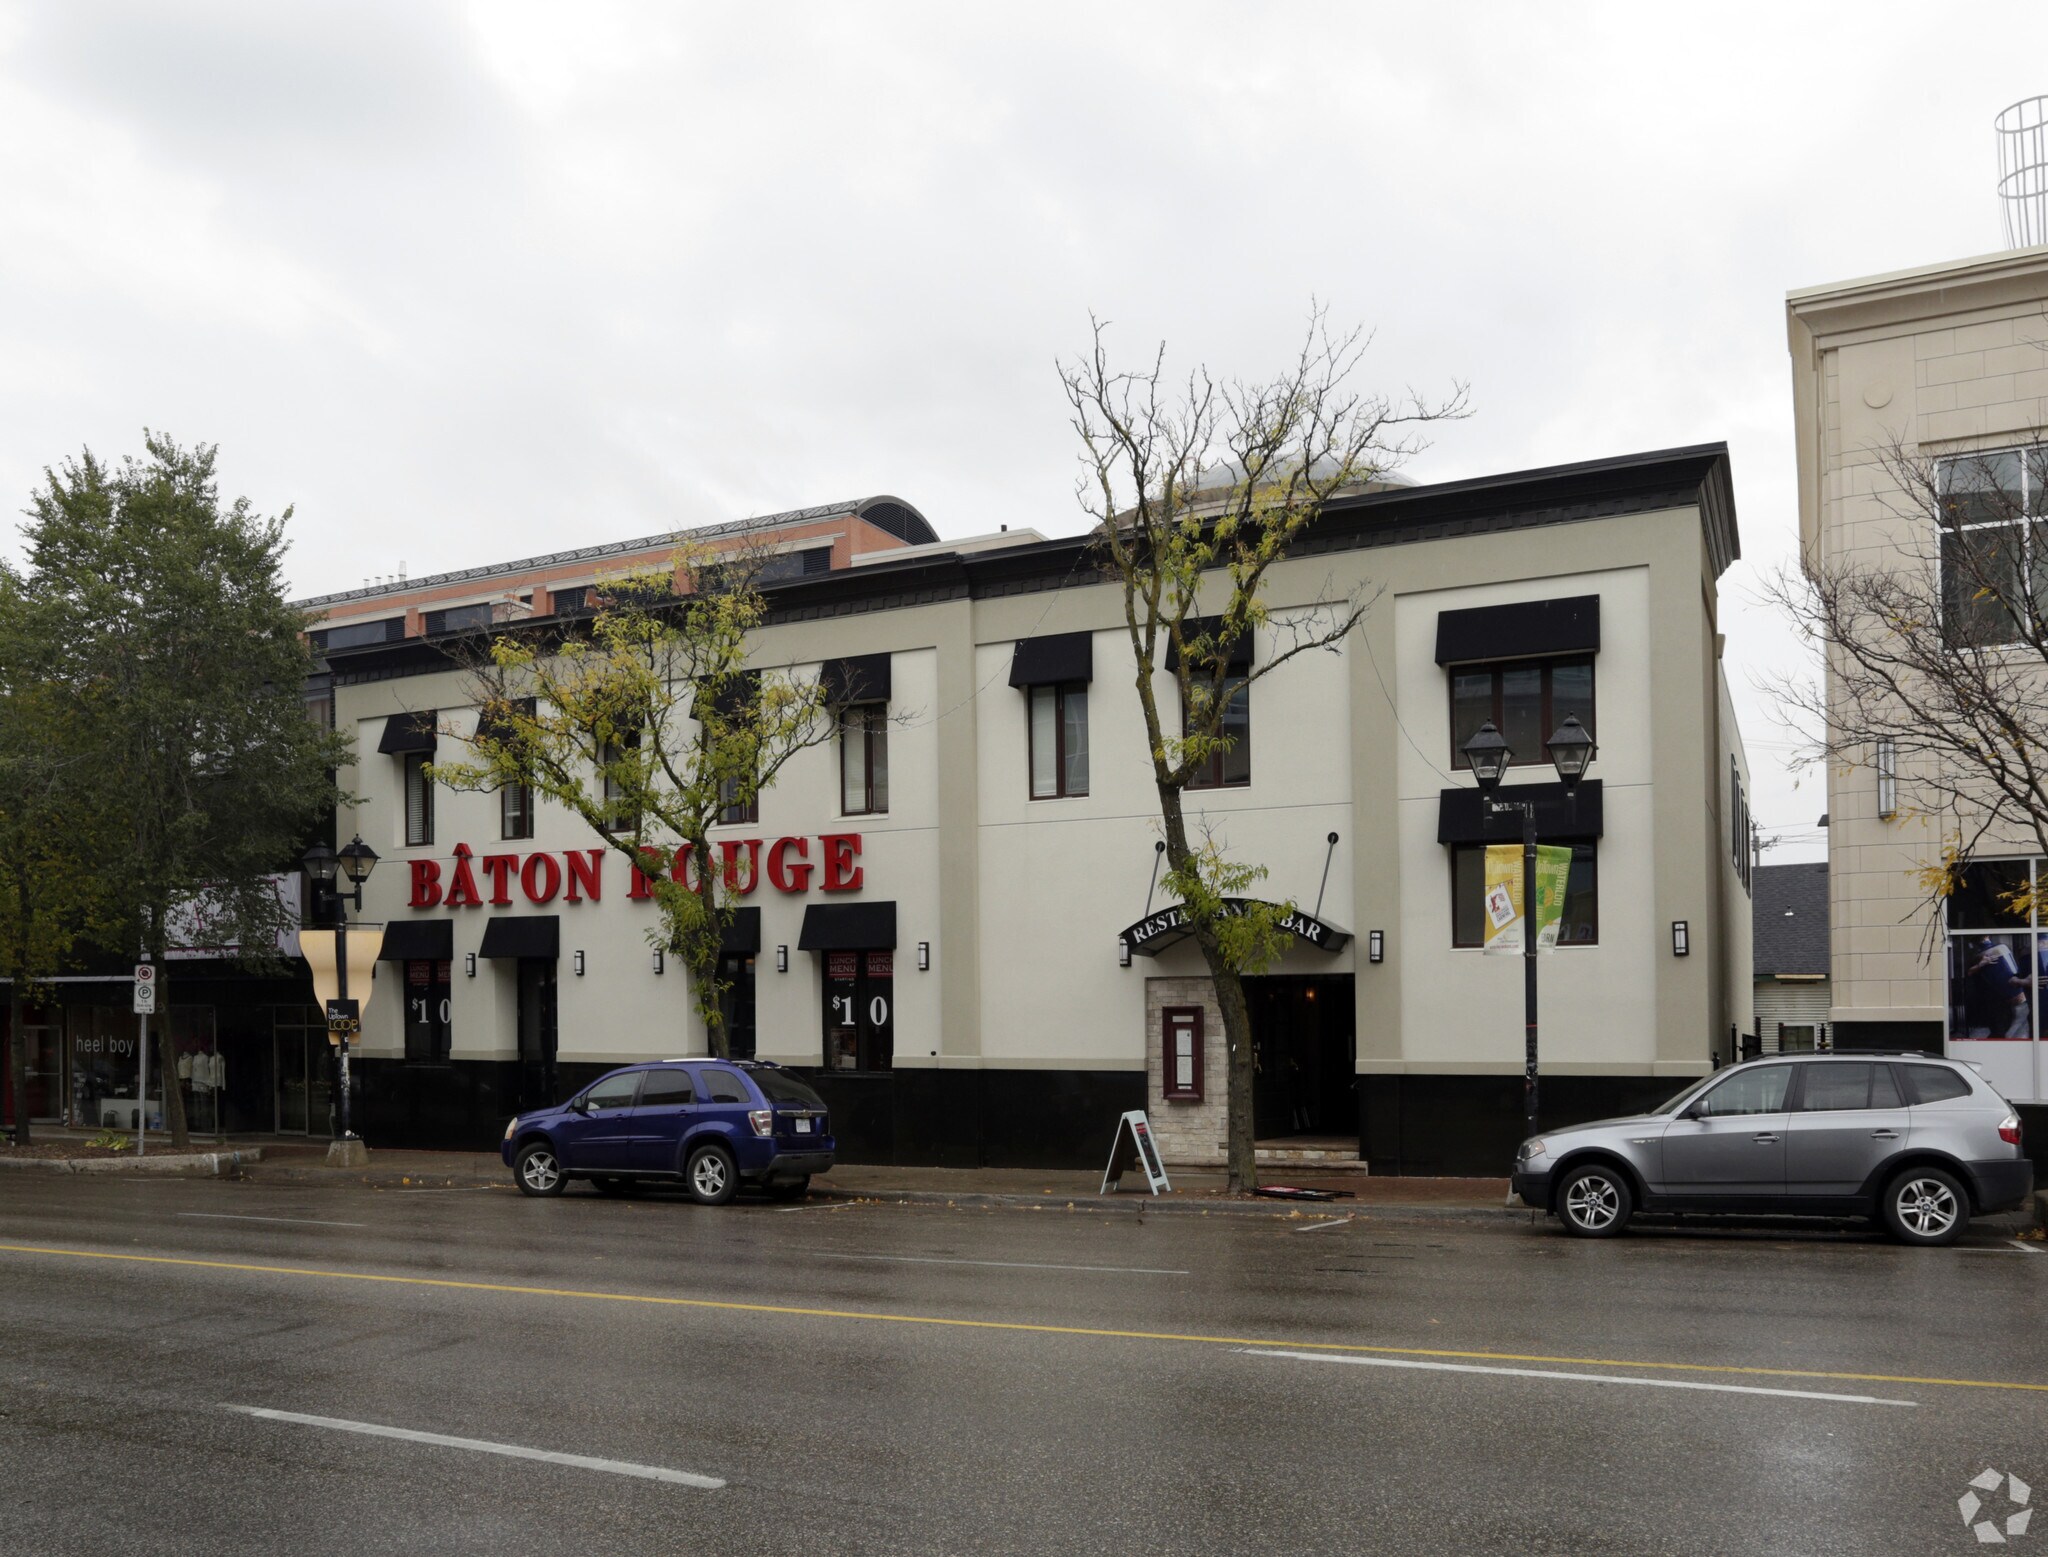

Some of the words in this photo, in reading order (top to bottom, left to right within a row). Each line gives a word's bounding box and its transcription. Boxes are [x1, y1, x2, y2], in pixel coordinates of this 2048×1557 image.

[408, 843, 605, 906] BÂTON
[1513, 860, 1522, 904] WATERLOO
[1553, 862, 1568, 906] WATERLOO
[1280, 912, 1321, 942] BAR
[829, 956, 856, 964] LUNCH
[829, 964, 856, 973] MENU
[328, 1019, 358, 1030] LOOP
[76, 1034, 104, 1053] heel
[109, 1034, 134, 1058] boy
